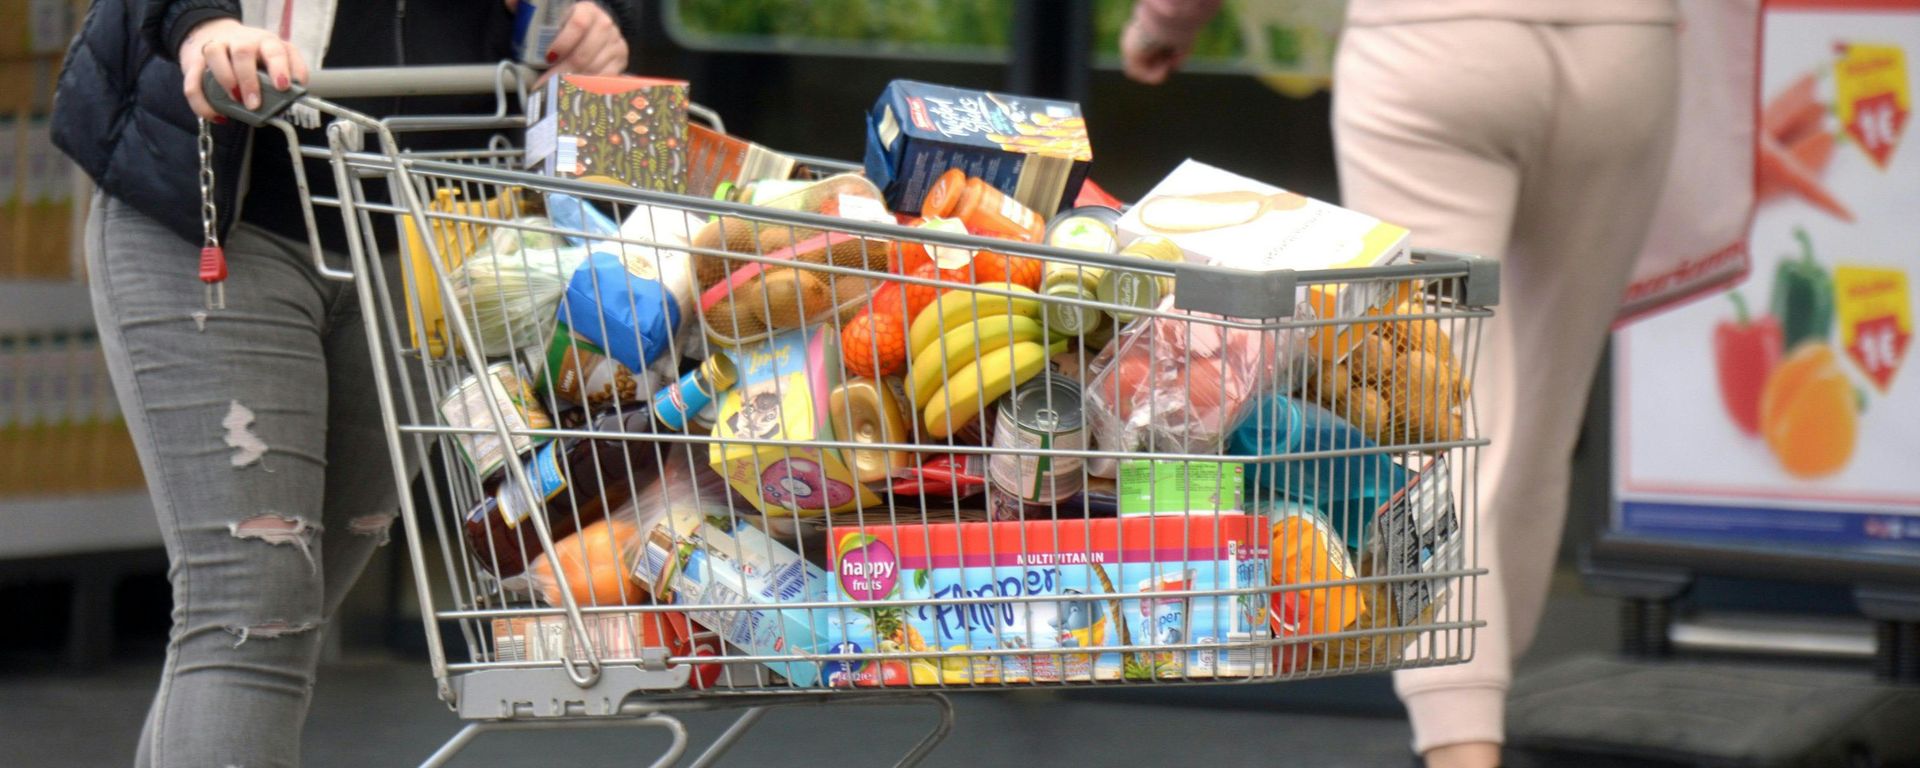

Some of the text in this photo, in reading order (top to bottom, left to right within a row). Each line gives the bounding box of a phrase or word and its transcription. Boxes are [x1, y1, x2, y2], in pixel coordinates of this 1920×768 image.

[1017, 552, 1105, 566] MULTIVITAMIN
[843, 559, 895, 580] happy
[852, 579, 882, 592] fruits
[919, 566, 1062, 641] Flipper
